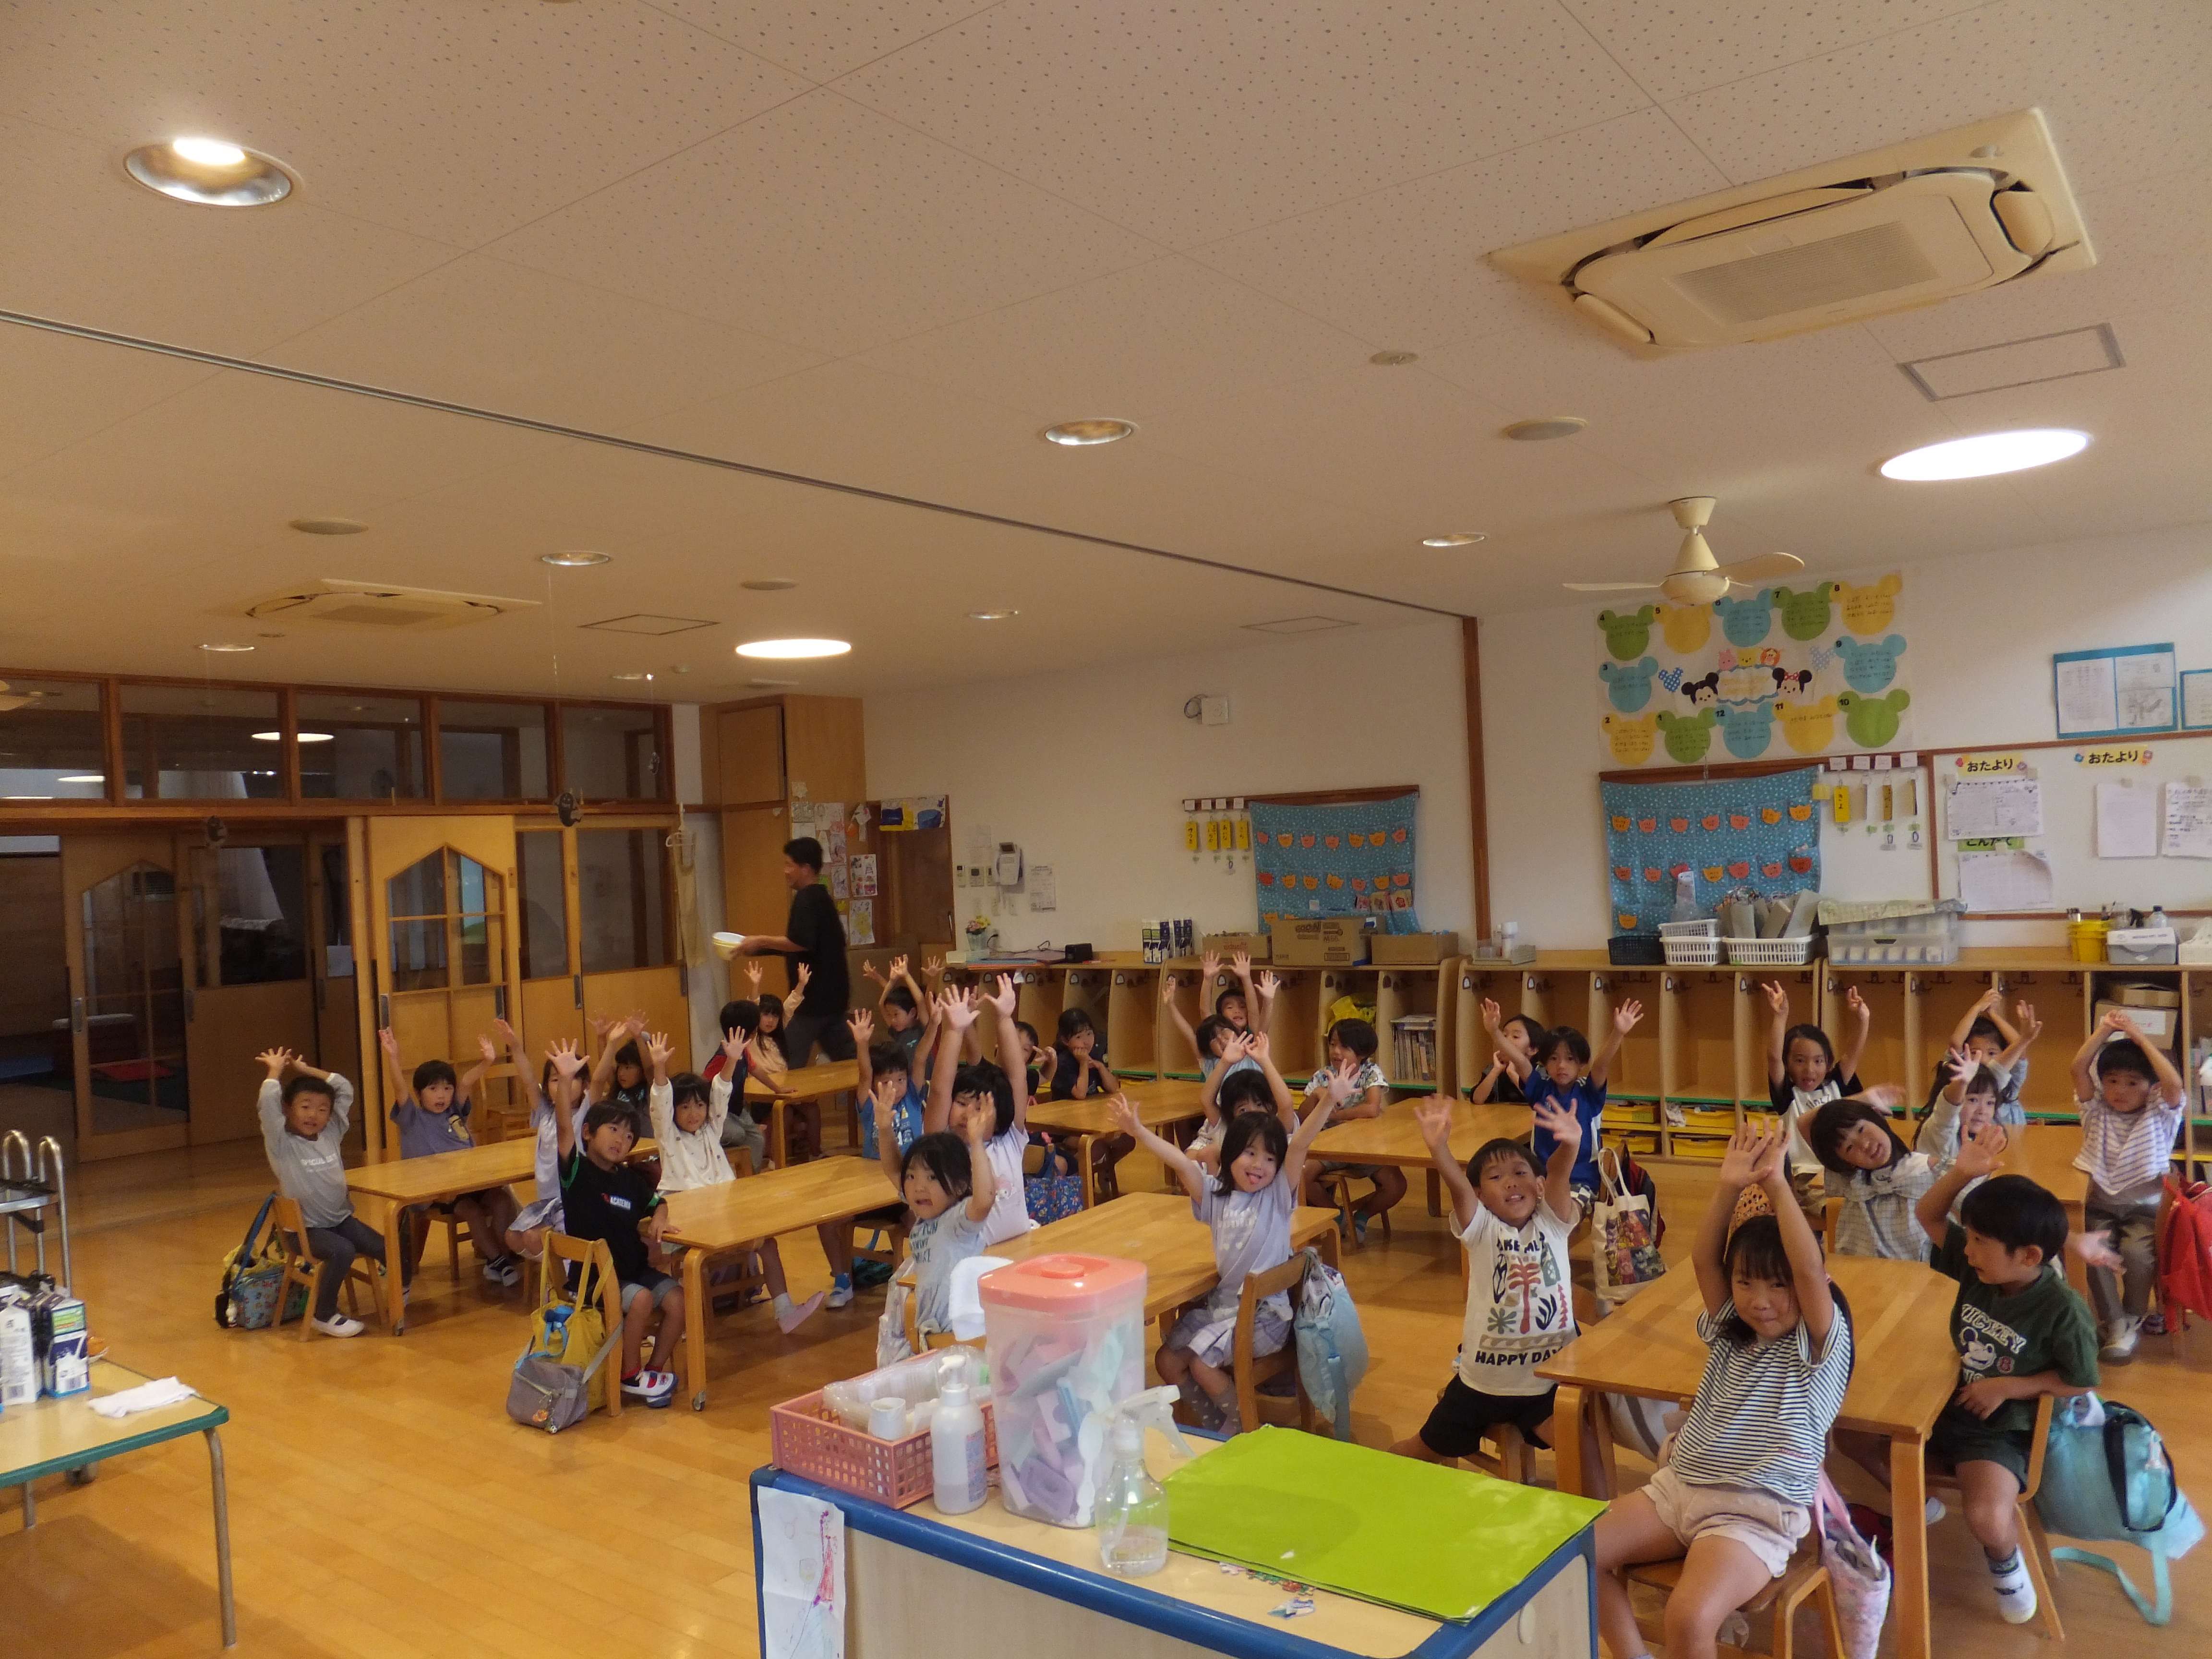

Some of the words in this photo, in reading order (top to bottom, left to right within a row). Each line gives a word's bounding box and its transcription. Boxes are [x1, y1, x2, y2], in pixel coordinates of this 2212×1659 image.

[2088, 750, 2138, 764] おたより
[1967, 758, 2013, 772] おたより
[1475, 1350, 1528, 1366] HAPPY
